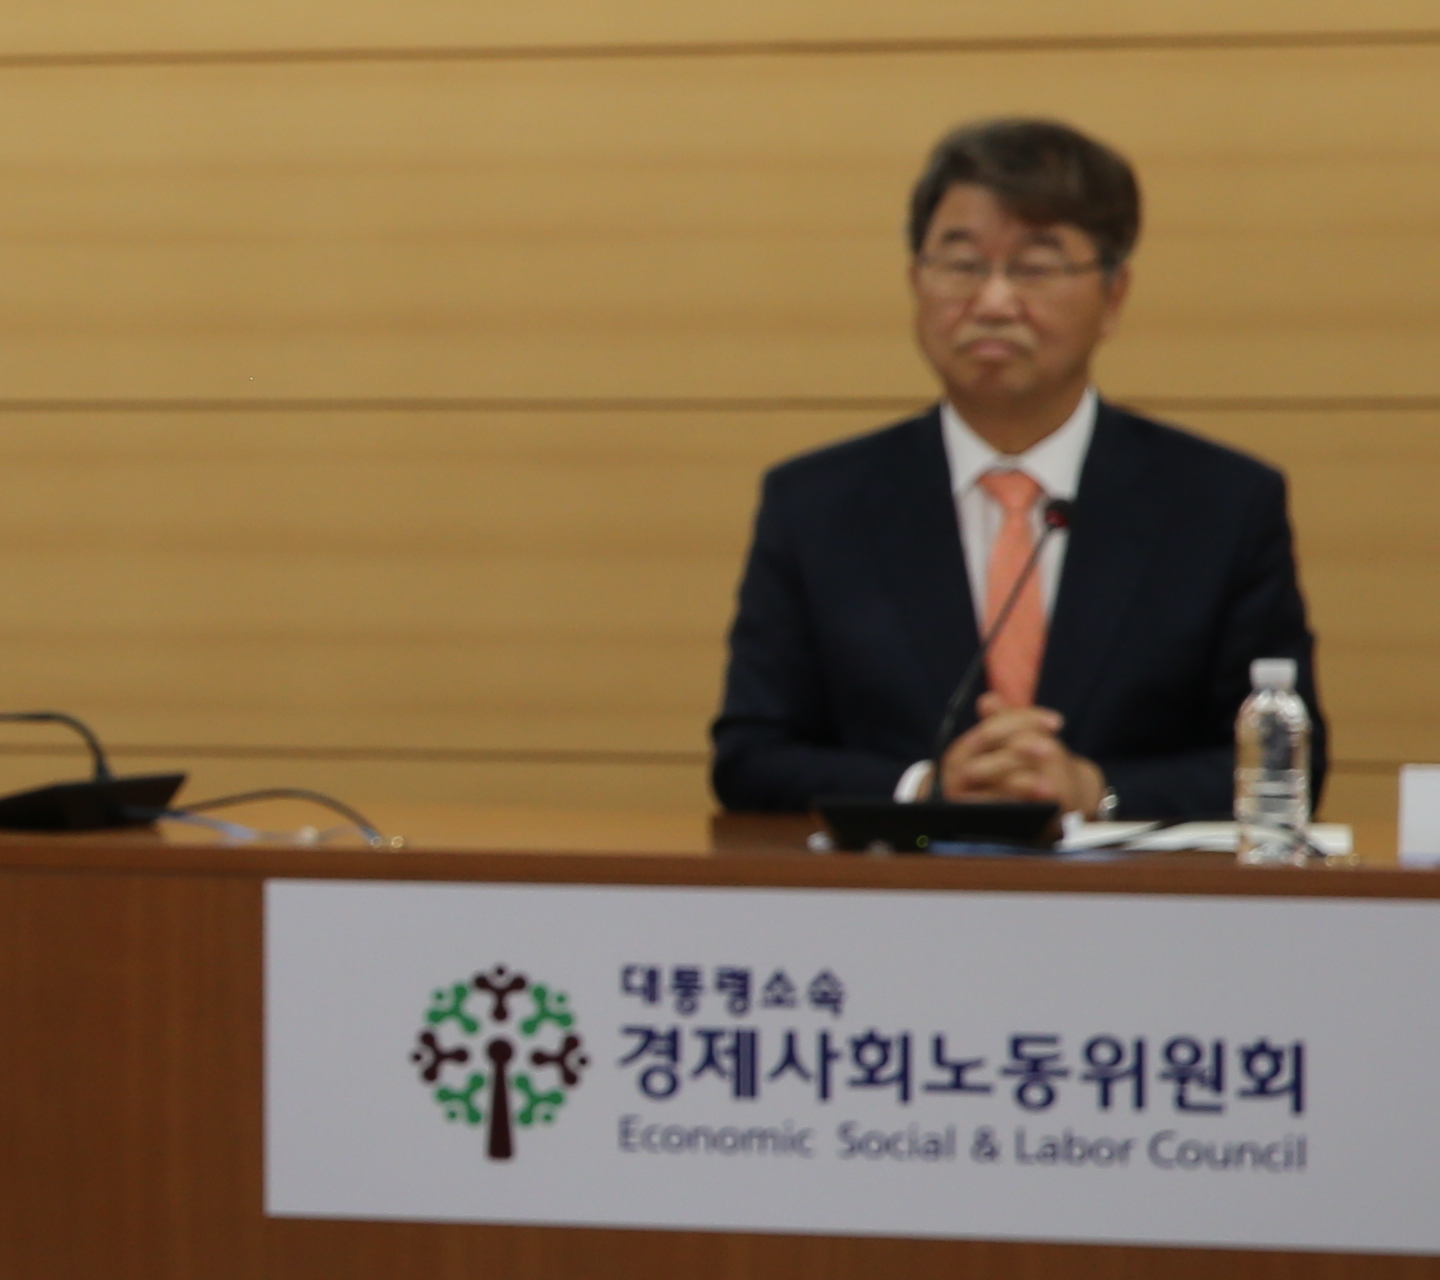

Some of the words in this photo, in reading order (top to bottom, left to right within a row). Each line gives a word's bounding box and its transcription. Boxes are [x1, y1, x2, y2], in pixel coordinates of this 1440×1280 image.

[620, 963, 845, 1017] 대통령소속
[617, 1024, 1307, 1115] 경제사회노동위원회
[617, 1114, 814, 1160] Economic
[836, 1120, 957, 1163] Social
[970, 1125, 1000, 1164] &
[1013, 1125, 1133, 1166] Labor
[1146, 1129, 1309, 1171] Council
